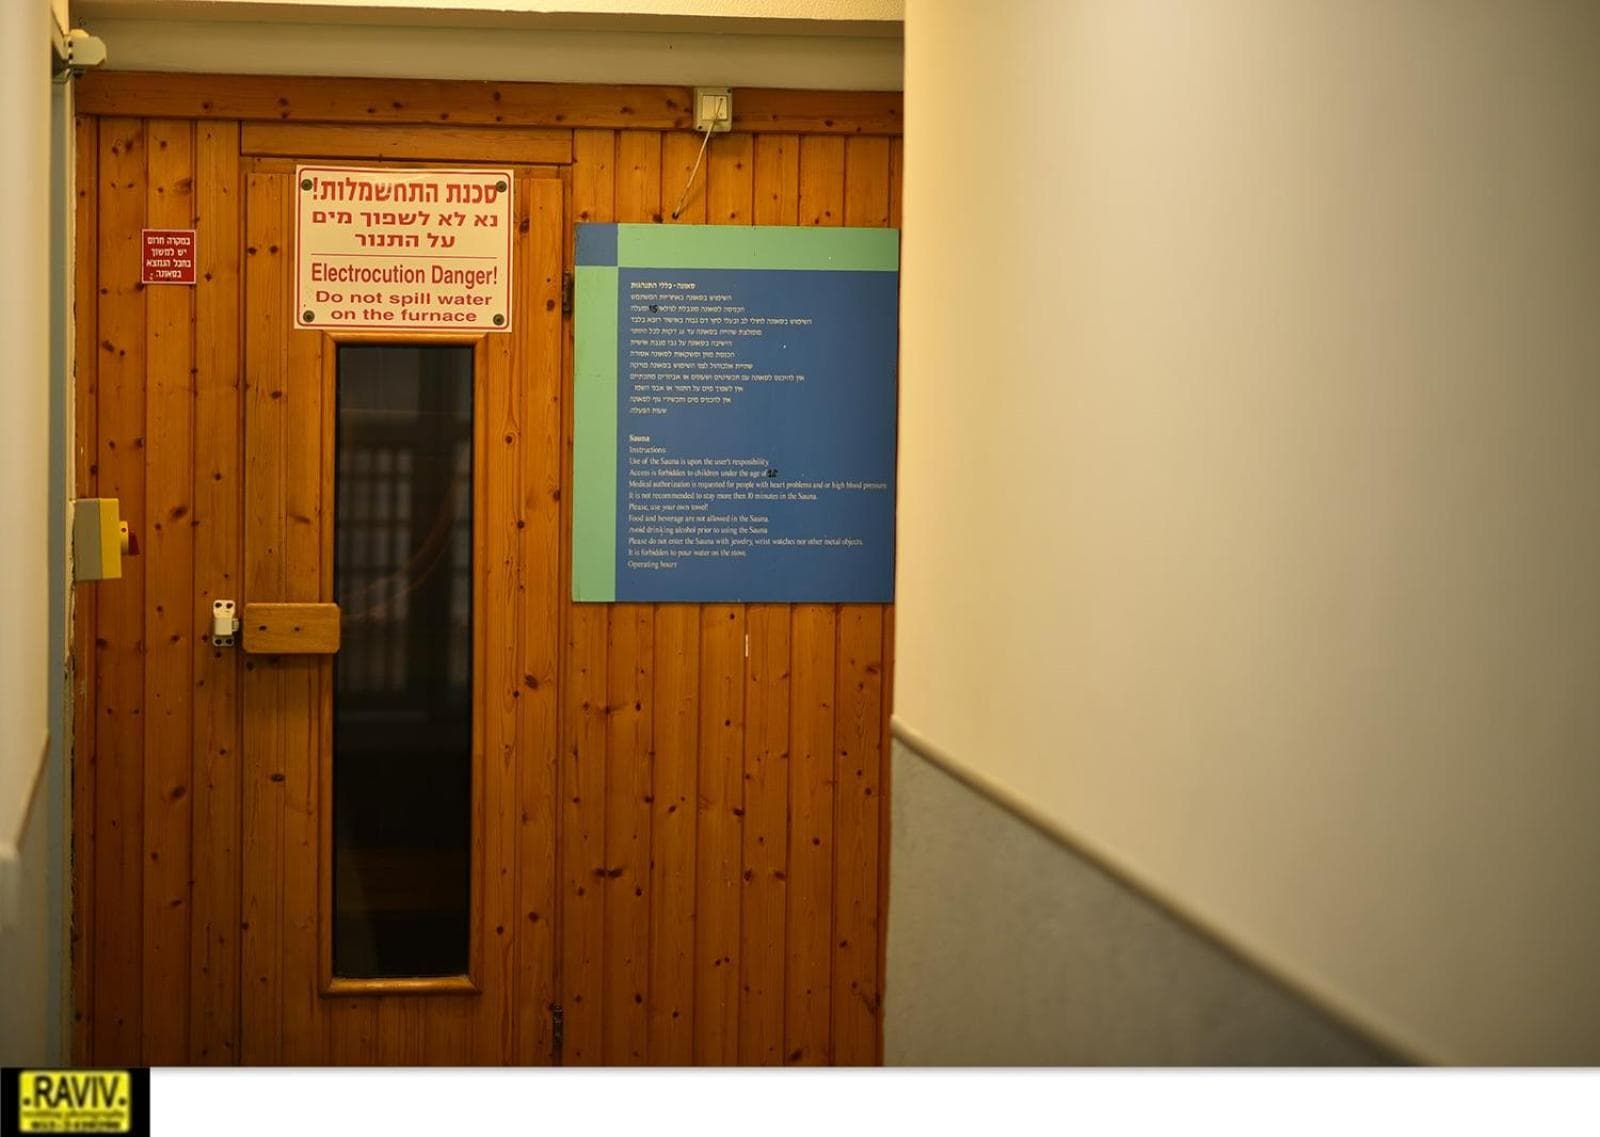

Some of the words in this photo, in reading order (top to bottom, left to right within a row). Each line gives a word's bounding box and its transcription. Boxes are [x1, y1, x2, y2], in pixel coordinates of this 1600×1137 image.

[312, 177, 438, 202] התחשמלות!
[446, 182, 498, 204] סכנת
[312, 211, 353, 224] מים
[360, 211, 430, 227] לשפוך
[438, 212, 466, 227] לא
[473, 214, 498, 227] נא
[354, 233, 420, 248] התנור
[427, 232, 455, 248] על
[151, 248, 175, 257] למשוך
[177, 248, 188, 256] יש
[312, 262, 426, 285] Electrocution
[431, 265, 498, 290] Danger!
[315, 290, 343, 303] Do
[350, 291, 382, 304] not
[389, 291, 431, 307] spill
[437, 294, 493, 306] water
[331, 310, 356, 321] on
[363, 309, 394, 321] the
[401, 309, 478, 322] furnace
[629, 434, 650, 442] Sauna
[687, 458, 702, 467] upon
[627, 561, 659, 570] Operating
